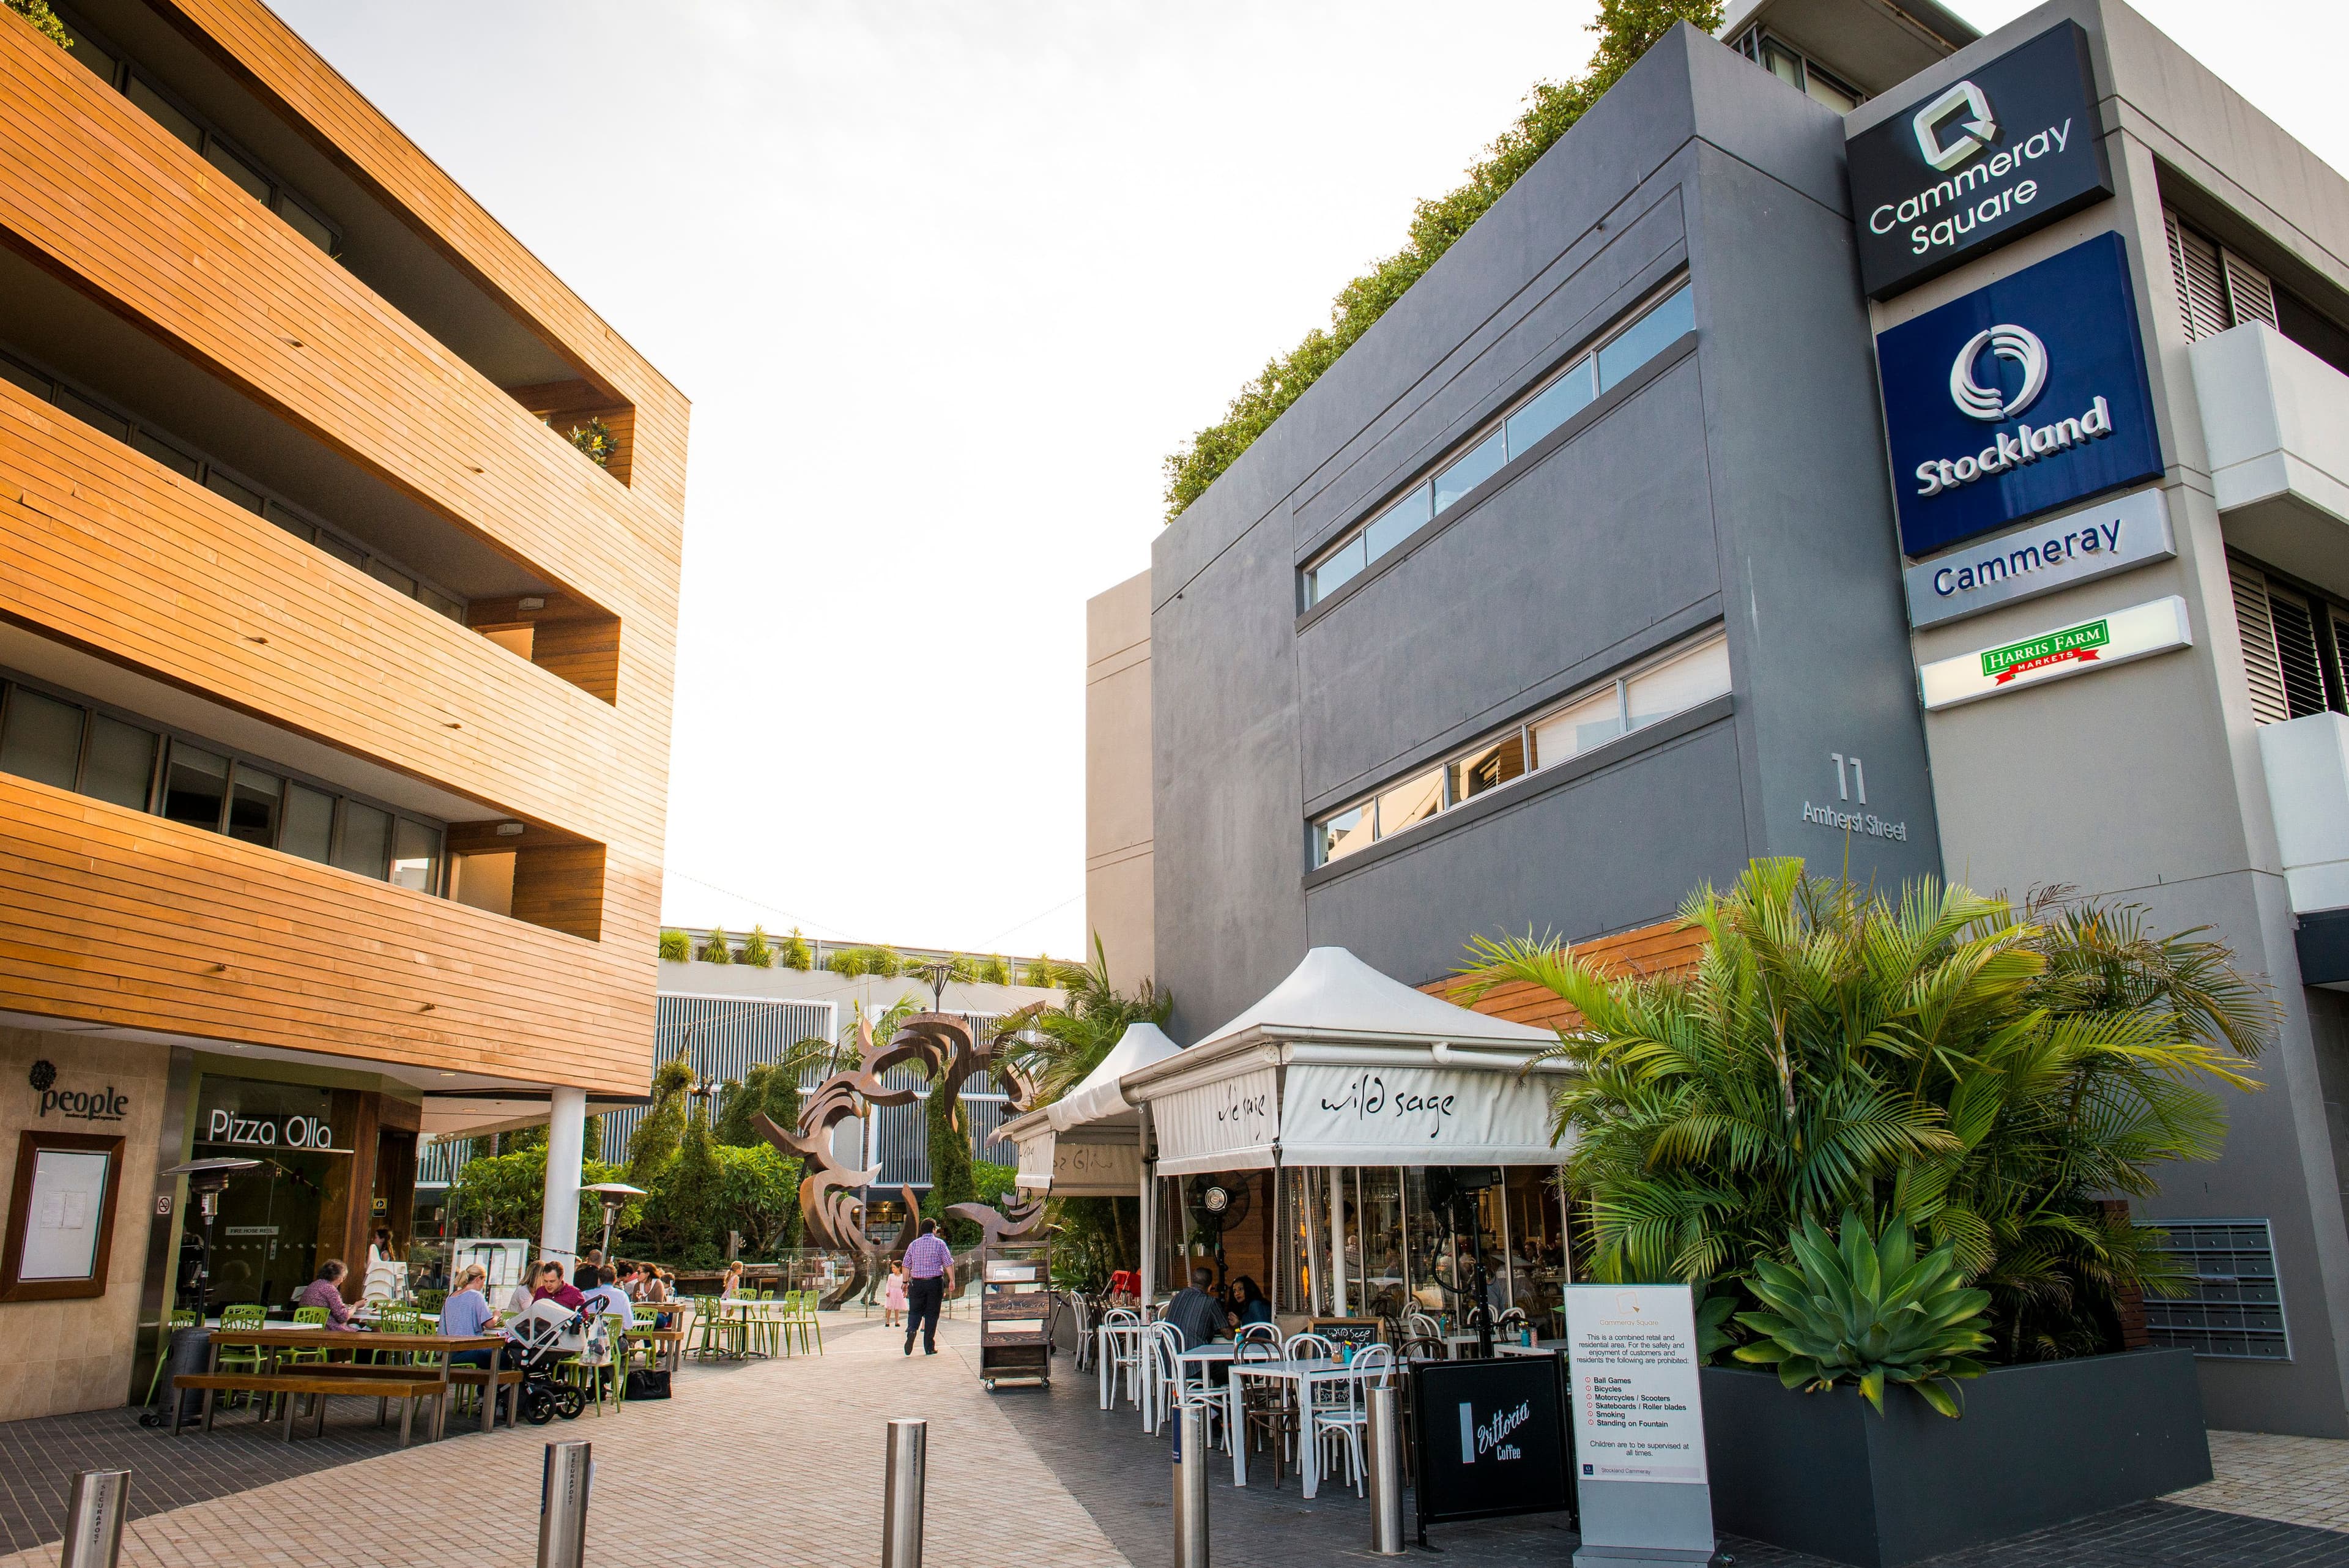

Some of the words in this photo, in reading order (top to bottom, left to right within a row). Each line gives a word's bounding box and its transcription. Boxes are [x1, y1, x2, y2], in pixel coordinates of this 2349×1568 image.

[1869, 117, 2071, 234] Cammeray
[1912, 179, 2037, 255] Square
[1916, 395, 2112, 496] Stockland
[1933, 519, 2121, 596] Cammeray
[1989, 642, 2049, 669] HARRIS
[2055, 628, 2101, 650] FARM
[2018, 650, 2074, 671] MARKETS
[1831, 752, 1866, 804] 11
[1802, 800, 1863, 833] Amherst
[1866, 814, 1907, 842] Street
[40, 1087, 129, 1120] people
[208, 1109, 275, 1145] Pizza
[286, 1115, 332, 1148] Olla
[1321, 1074, 1385, 1121] wild
[1395, 1092, 1454, 1139] sage
[1477, 1400, 1529, 1454] Vittoria
[1497, 1443, 1521, 1461] Coffee
[568, 1452, 576, 1505] SECURAPOST
[93, 1484, 106, 1545] SECURAPOST
